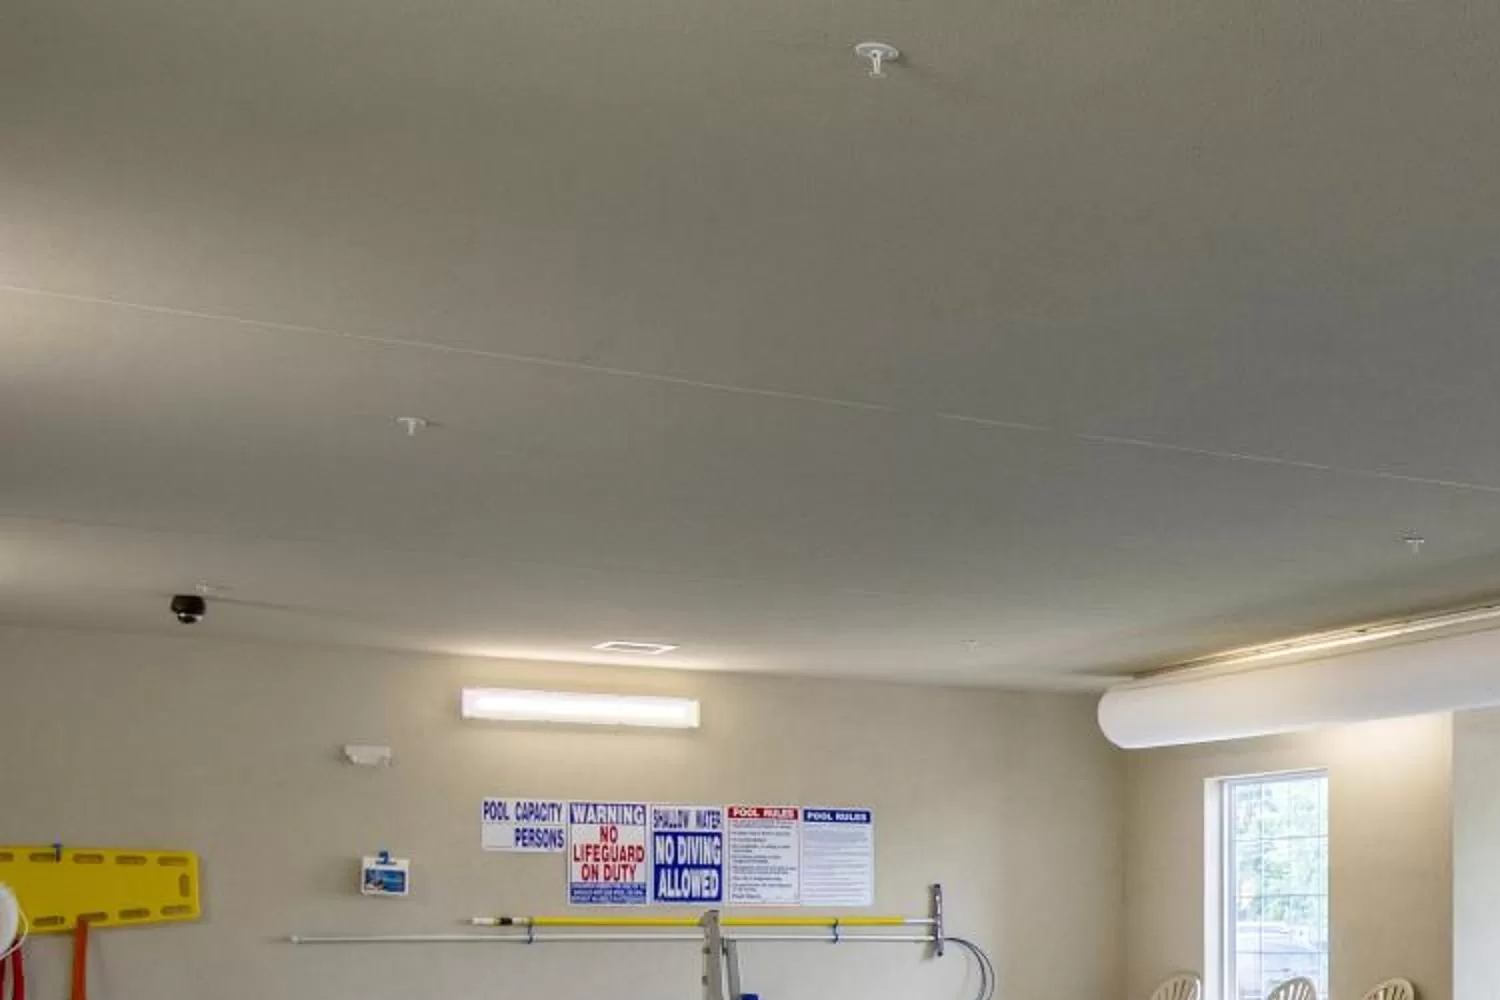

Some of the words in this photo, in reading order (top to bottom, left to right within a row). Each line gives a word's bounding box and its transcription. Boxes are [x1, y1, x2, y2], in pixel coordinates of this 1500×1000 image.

[484, 801, 510, 820] POOL
[515, 802, 563, 821] CAPACITY
[572, 804, 644, 824] WARNING
[733, 807, 760, 818] POOL
[763, 808, 795, 819] RULES
[807, 811, 833, 821] POOL
[835, 812, 867, 821] RULES
[514, 828, 564, 848] PERSONS
[601, 826, 618, 843] NO
[573, 844, 645, 863] LIFEGUARD
[655, 835, 675, 865] NO
[677, 835, 721, 865] DIVING
[581, 864, 599, 881] ON
[604, 864, 638, 881] DUTY
[657, 867, 720, 898] ALLOWED
